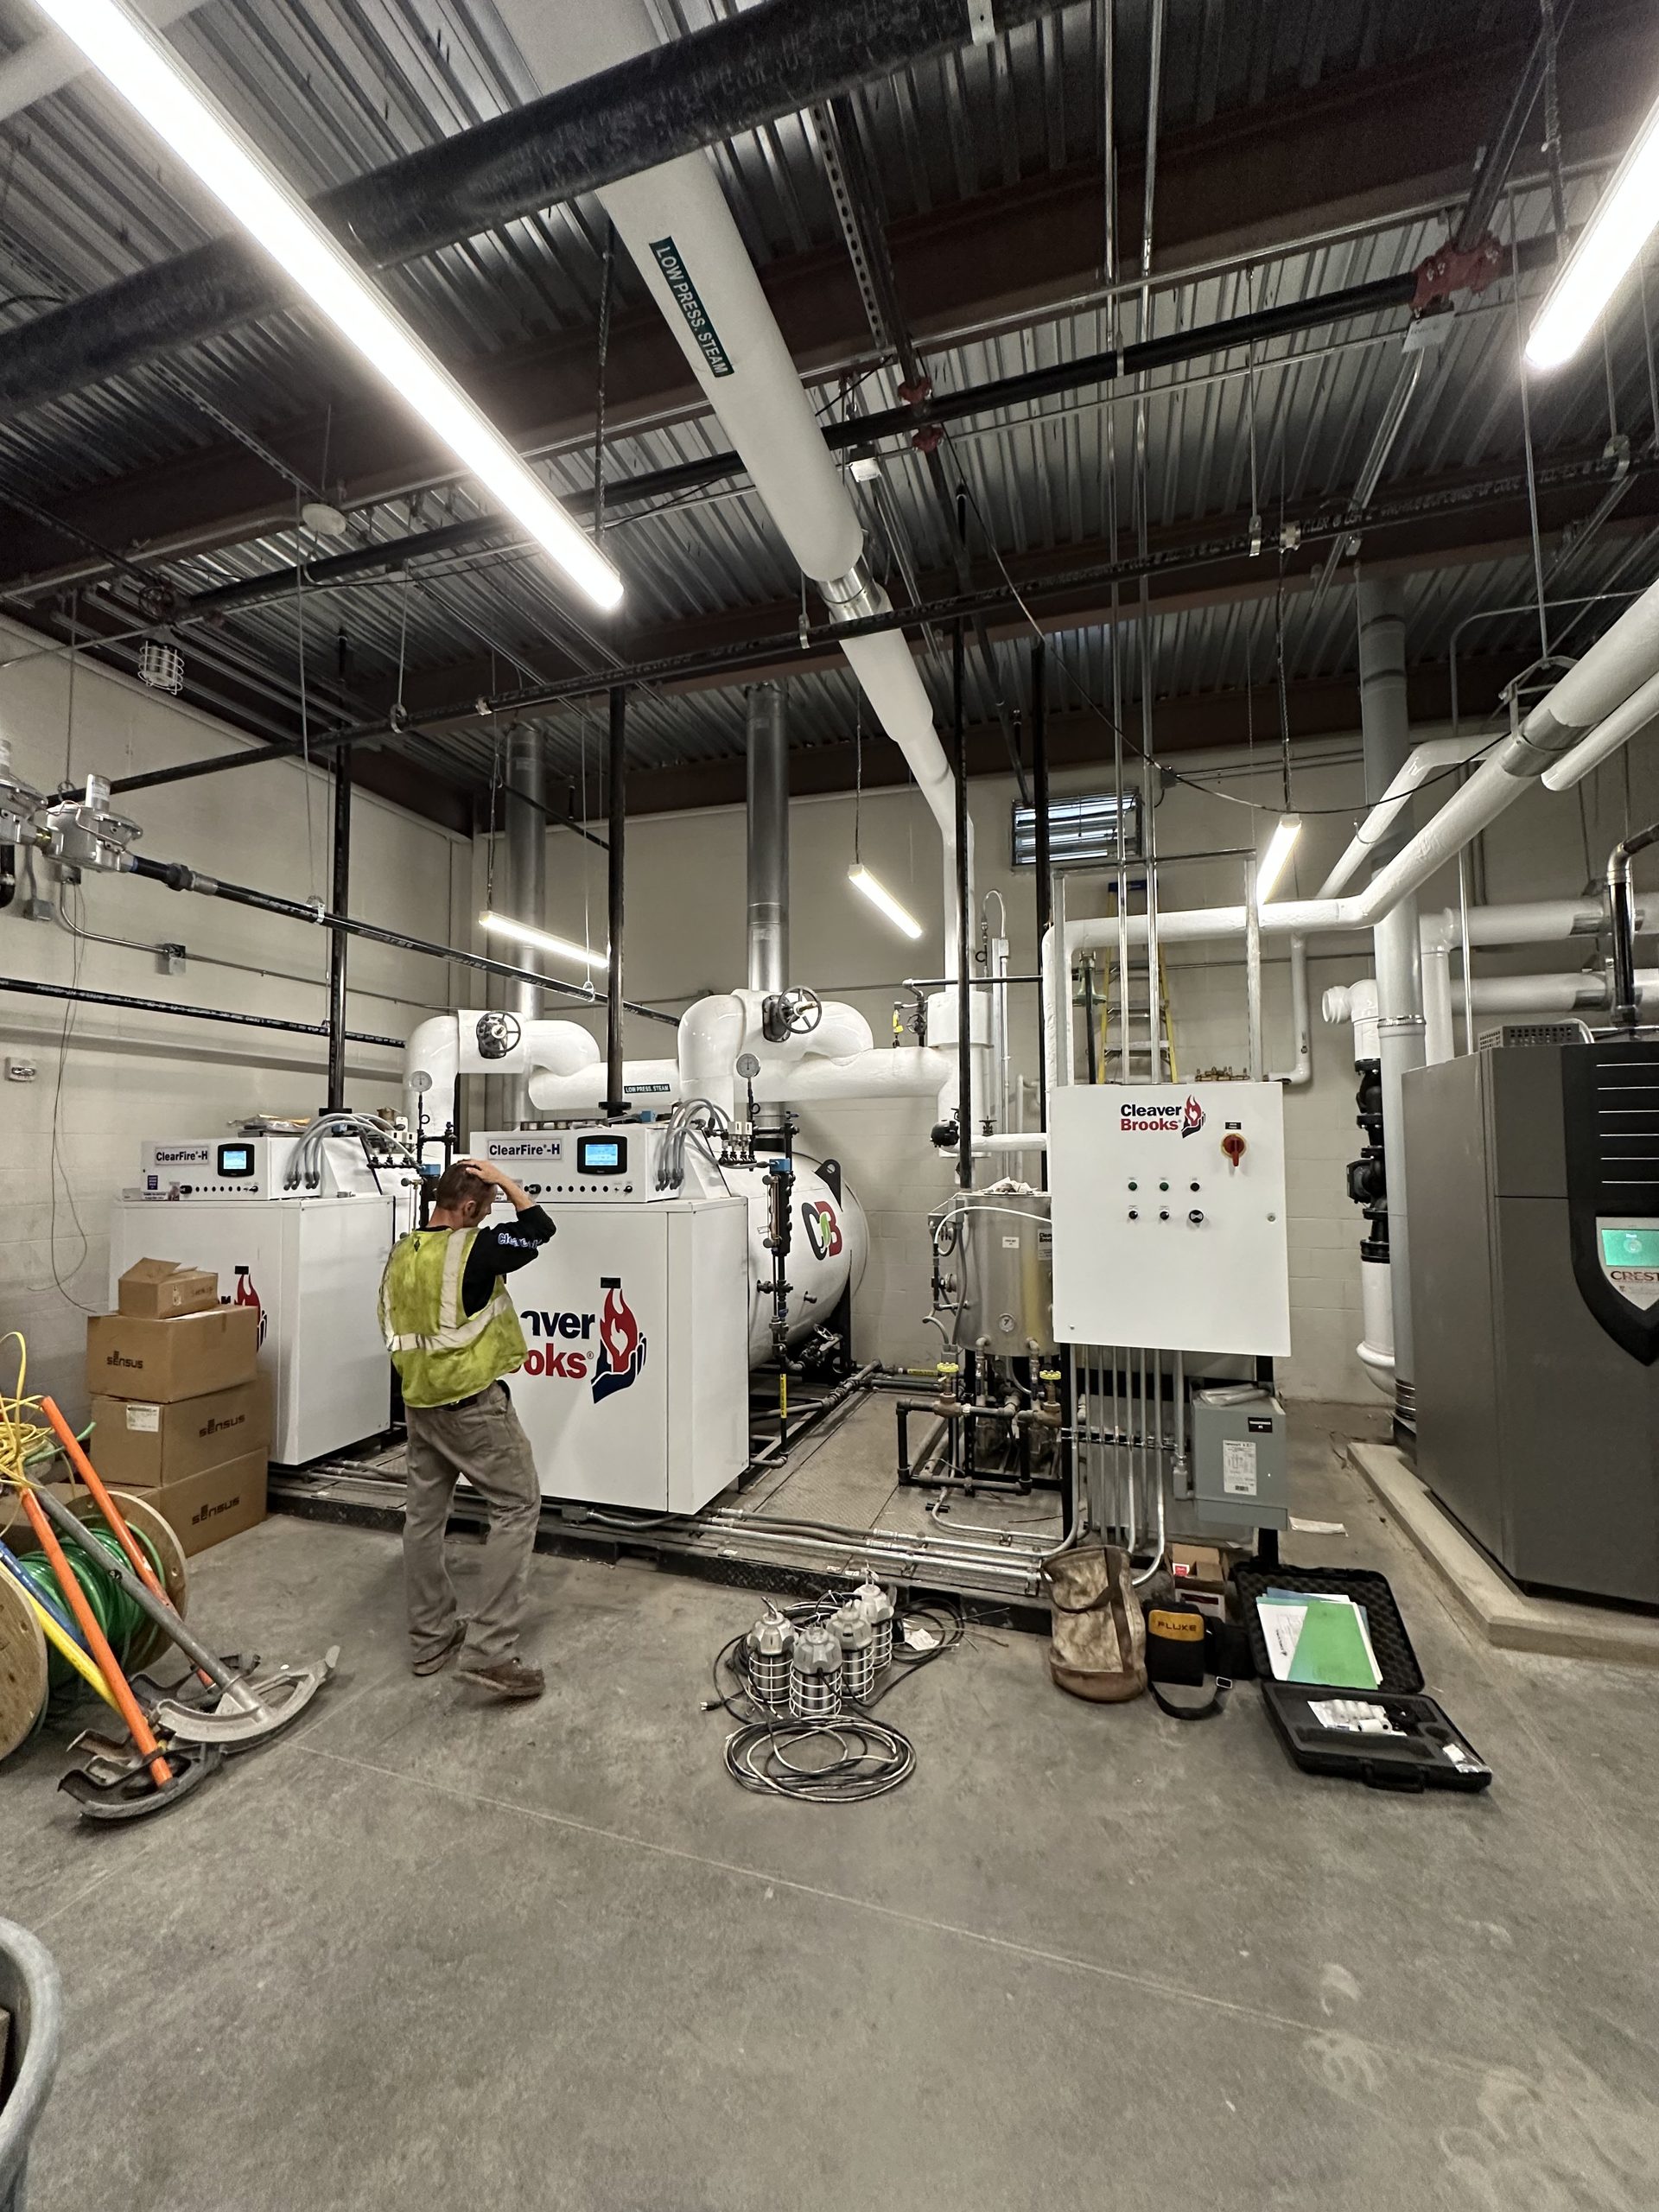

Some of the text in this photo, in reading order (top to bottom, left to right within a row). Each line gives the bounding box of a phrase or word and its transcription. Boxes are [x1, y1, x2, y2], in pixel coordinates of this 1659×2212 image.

[656, 246, 728, 374] LOW PRESS. STEAM
[1121, 1103, 1182, 1116] Cleaver
[1158, 1621, 1197, 1631] FLUKE
